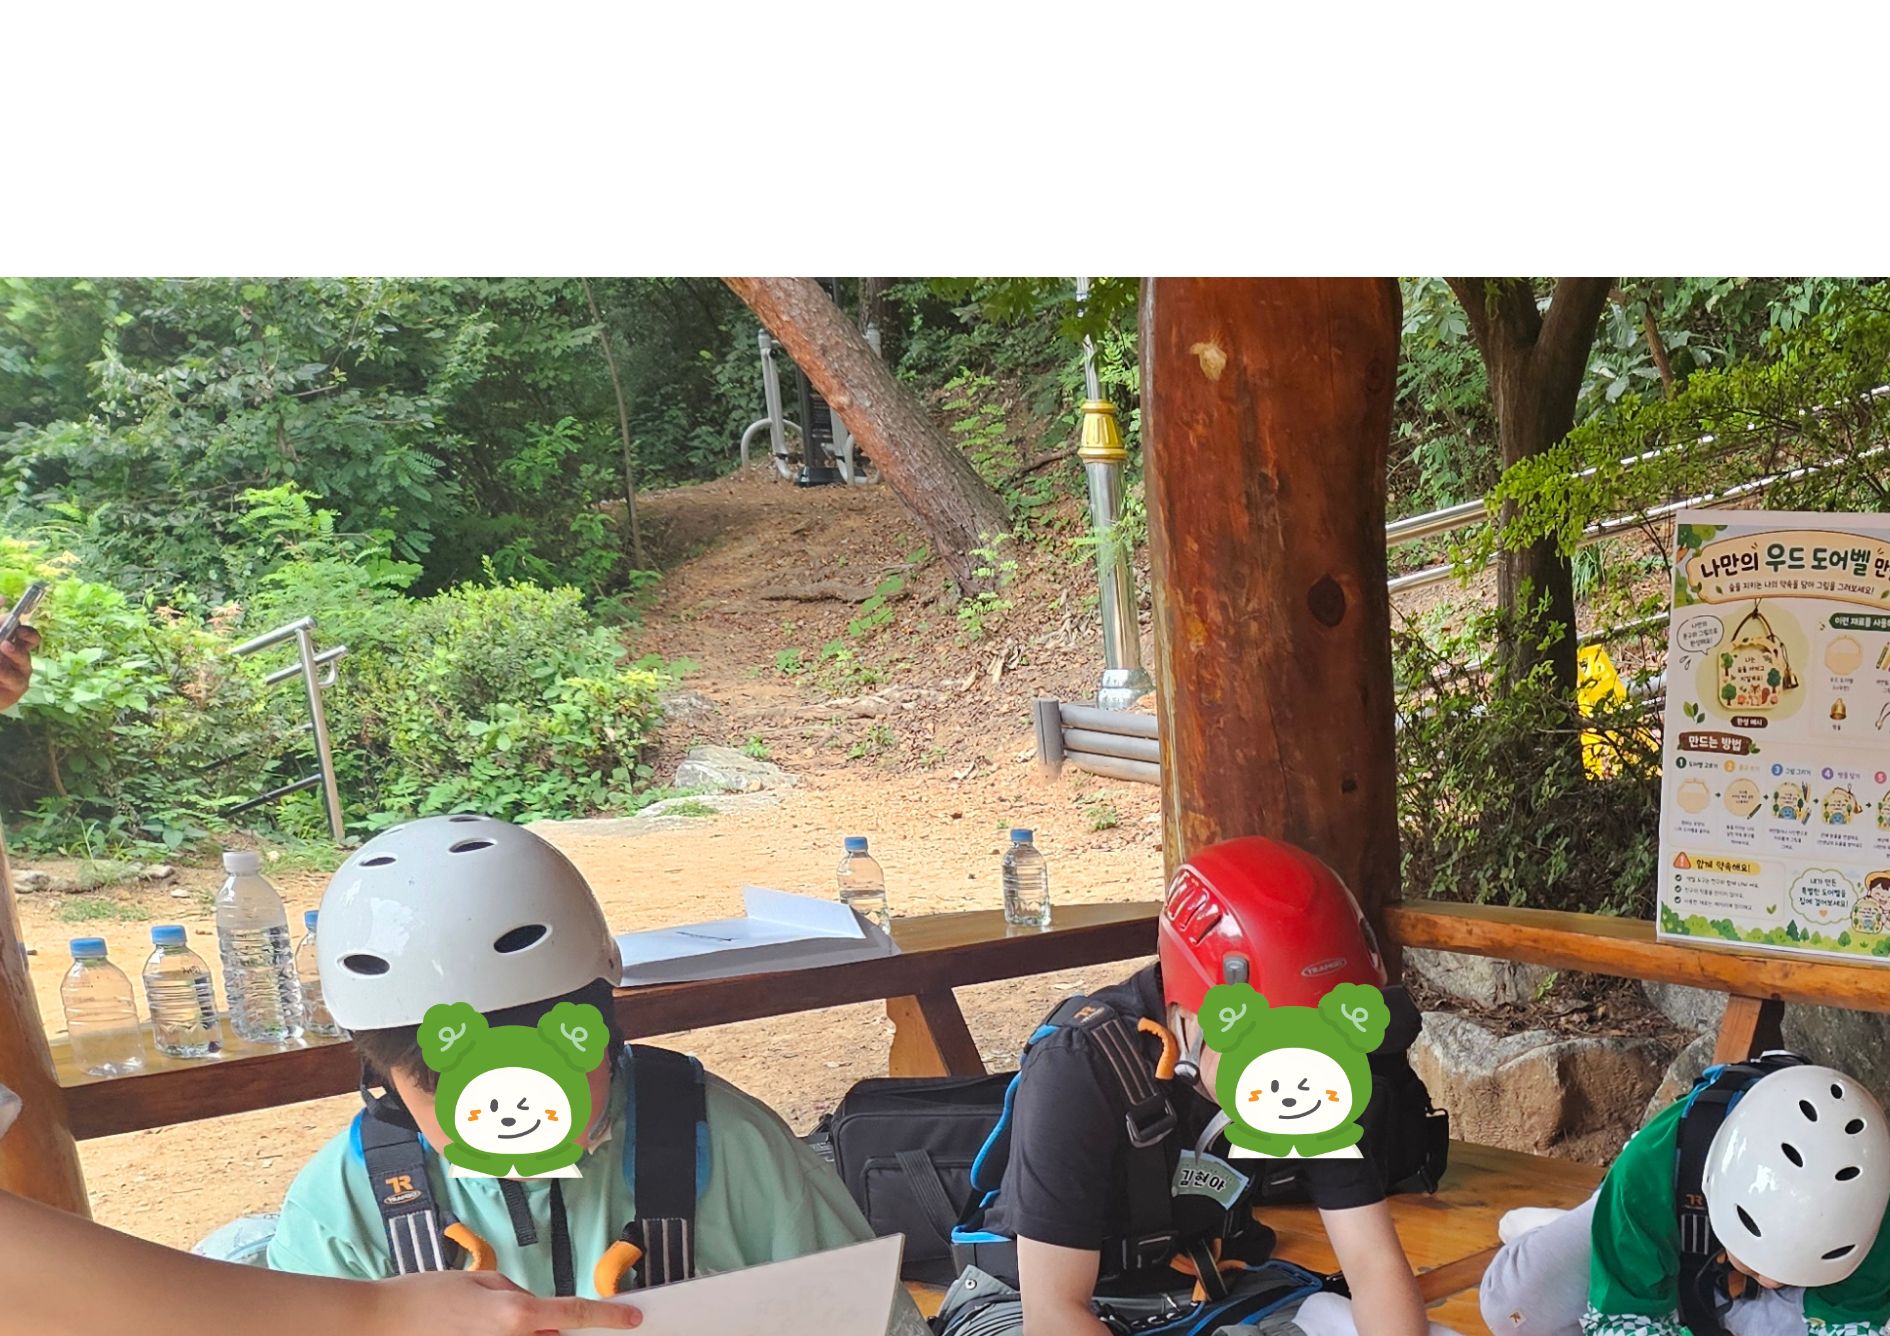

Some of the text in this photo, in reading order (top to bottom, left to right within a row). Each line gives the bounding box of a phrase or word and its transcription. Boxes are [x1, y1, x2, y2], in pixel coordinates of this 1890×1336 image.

[1701, 552, 1759, 578] 나만의
[1765, 543, 1806, 572] 우드
[1812, 548, 1871, 576] 도어벨
[1729, 580, 1875, 595] 숲을 지키는 나의 약속을 담아 그림을 그려보세요!
[1834, 617, 1849, 626] 이런
[1688, 735, 1742, 752] 만드는 방법
[1696, 859, 1751, 873] 함께 약속해요!
[1825, 878, 1837, 887] 만든
[1801, 887, 1846, 898] 특별한 도어벨을
[1799, 897, 1849, 908] 집에 걸어보세요!
[1180, 1169, 1225, 1191] 김현아
